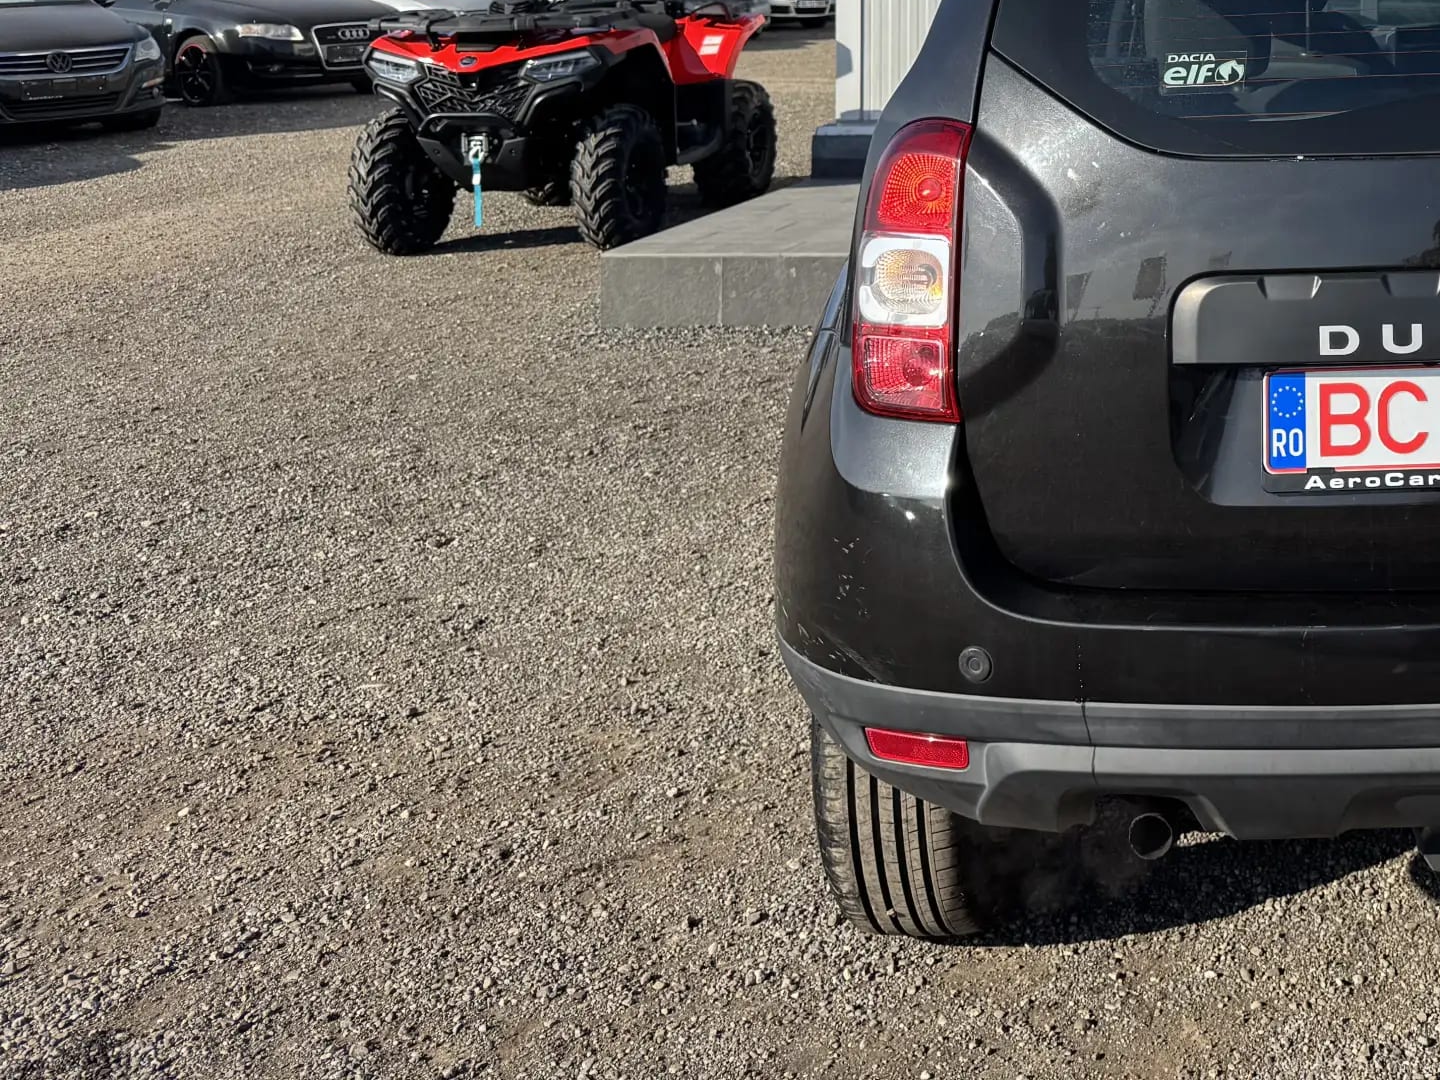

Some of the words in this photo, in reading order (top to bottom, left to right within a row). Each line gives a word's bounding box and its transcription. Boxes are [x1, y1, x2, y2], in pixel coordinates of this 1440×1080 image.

[1167, 53, 1216, 63] DACIA
[1163, 63, 1215, 85] elf
[1319, 380, 1429, 458] BC
[1272, 428, 1304, 458] RO
